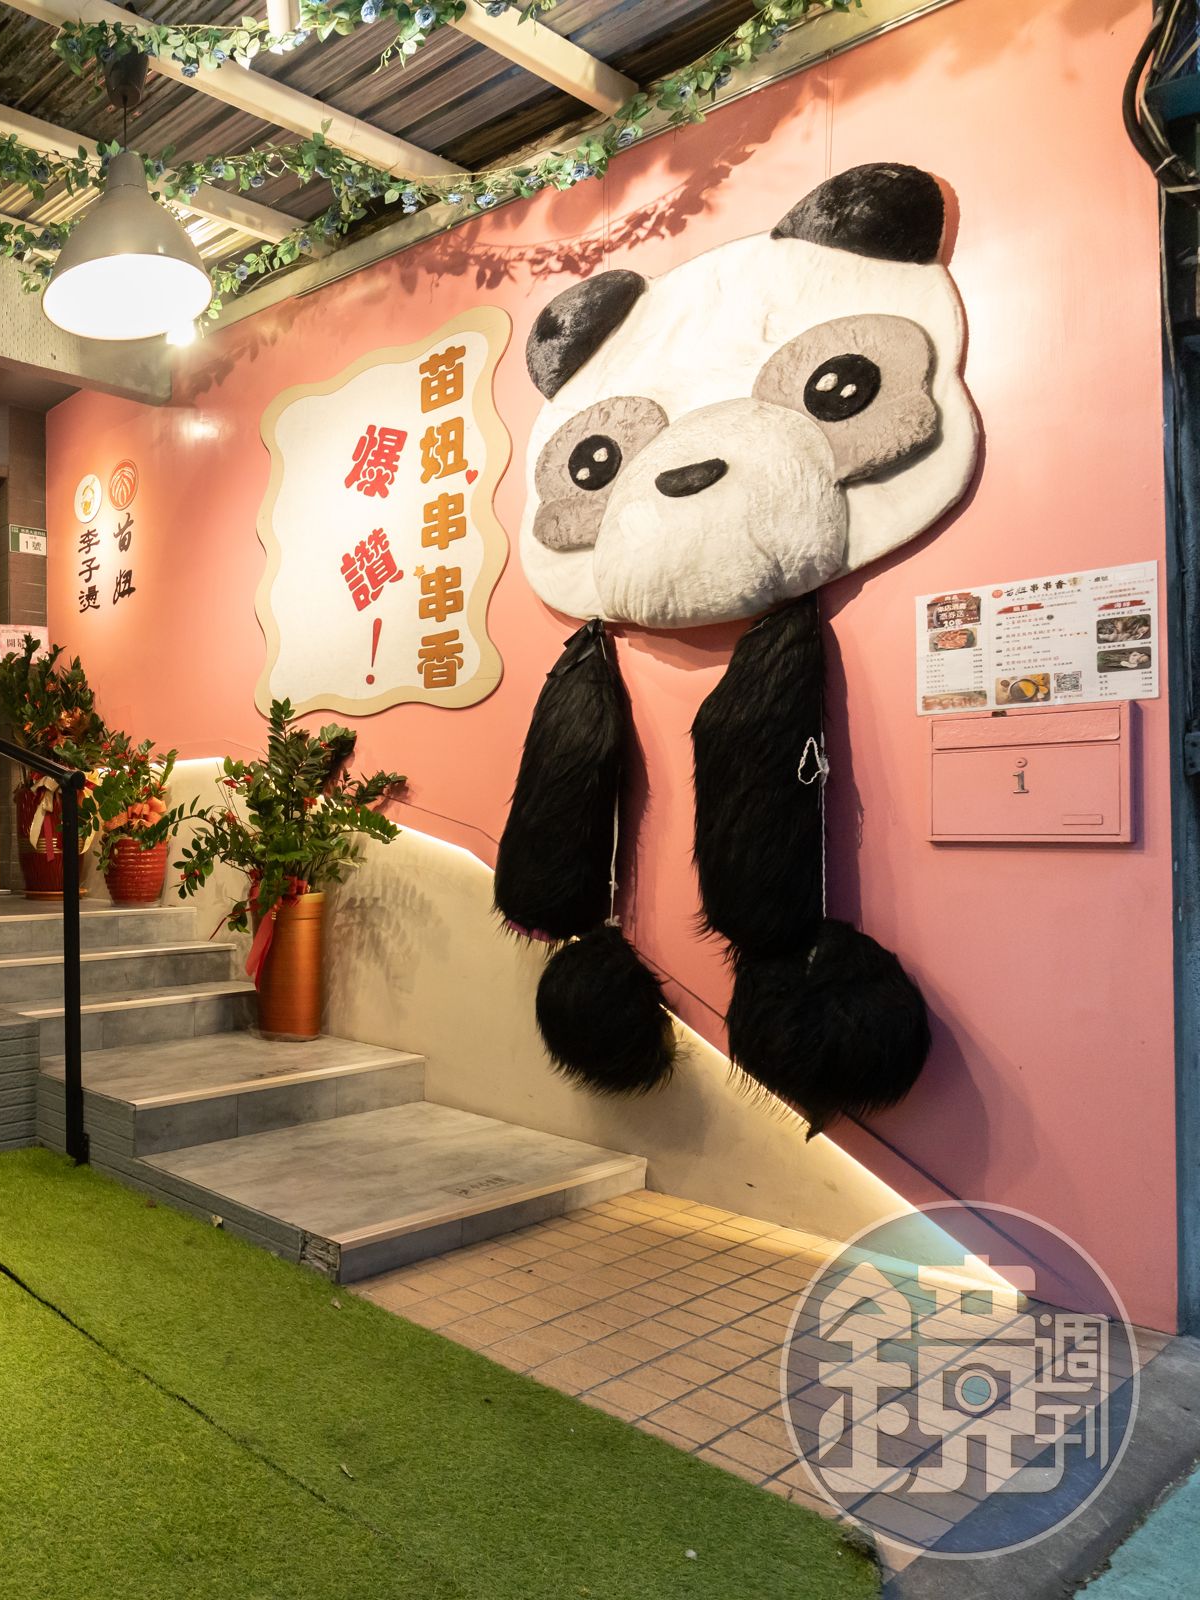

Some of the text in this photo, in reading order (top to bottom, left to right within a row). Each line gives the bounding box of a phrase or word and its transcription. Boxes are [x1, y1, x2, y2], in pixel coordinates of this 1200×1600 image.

[113, 512, 136, 606] 苗妞
[417, 345, 468, 689] 苗妞串串香
[78, 528, 101, 614] 李子燙
